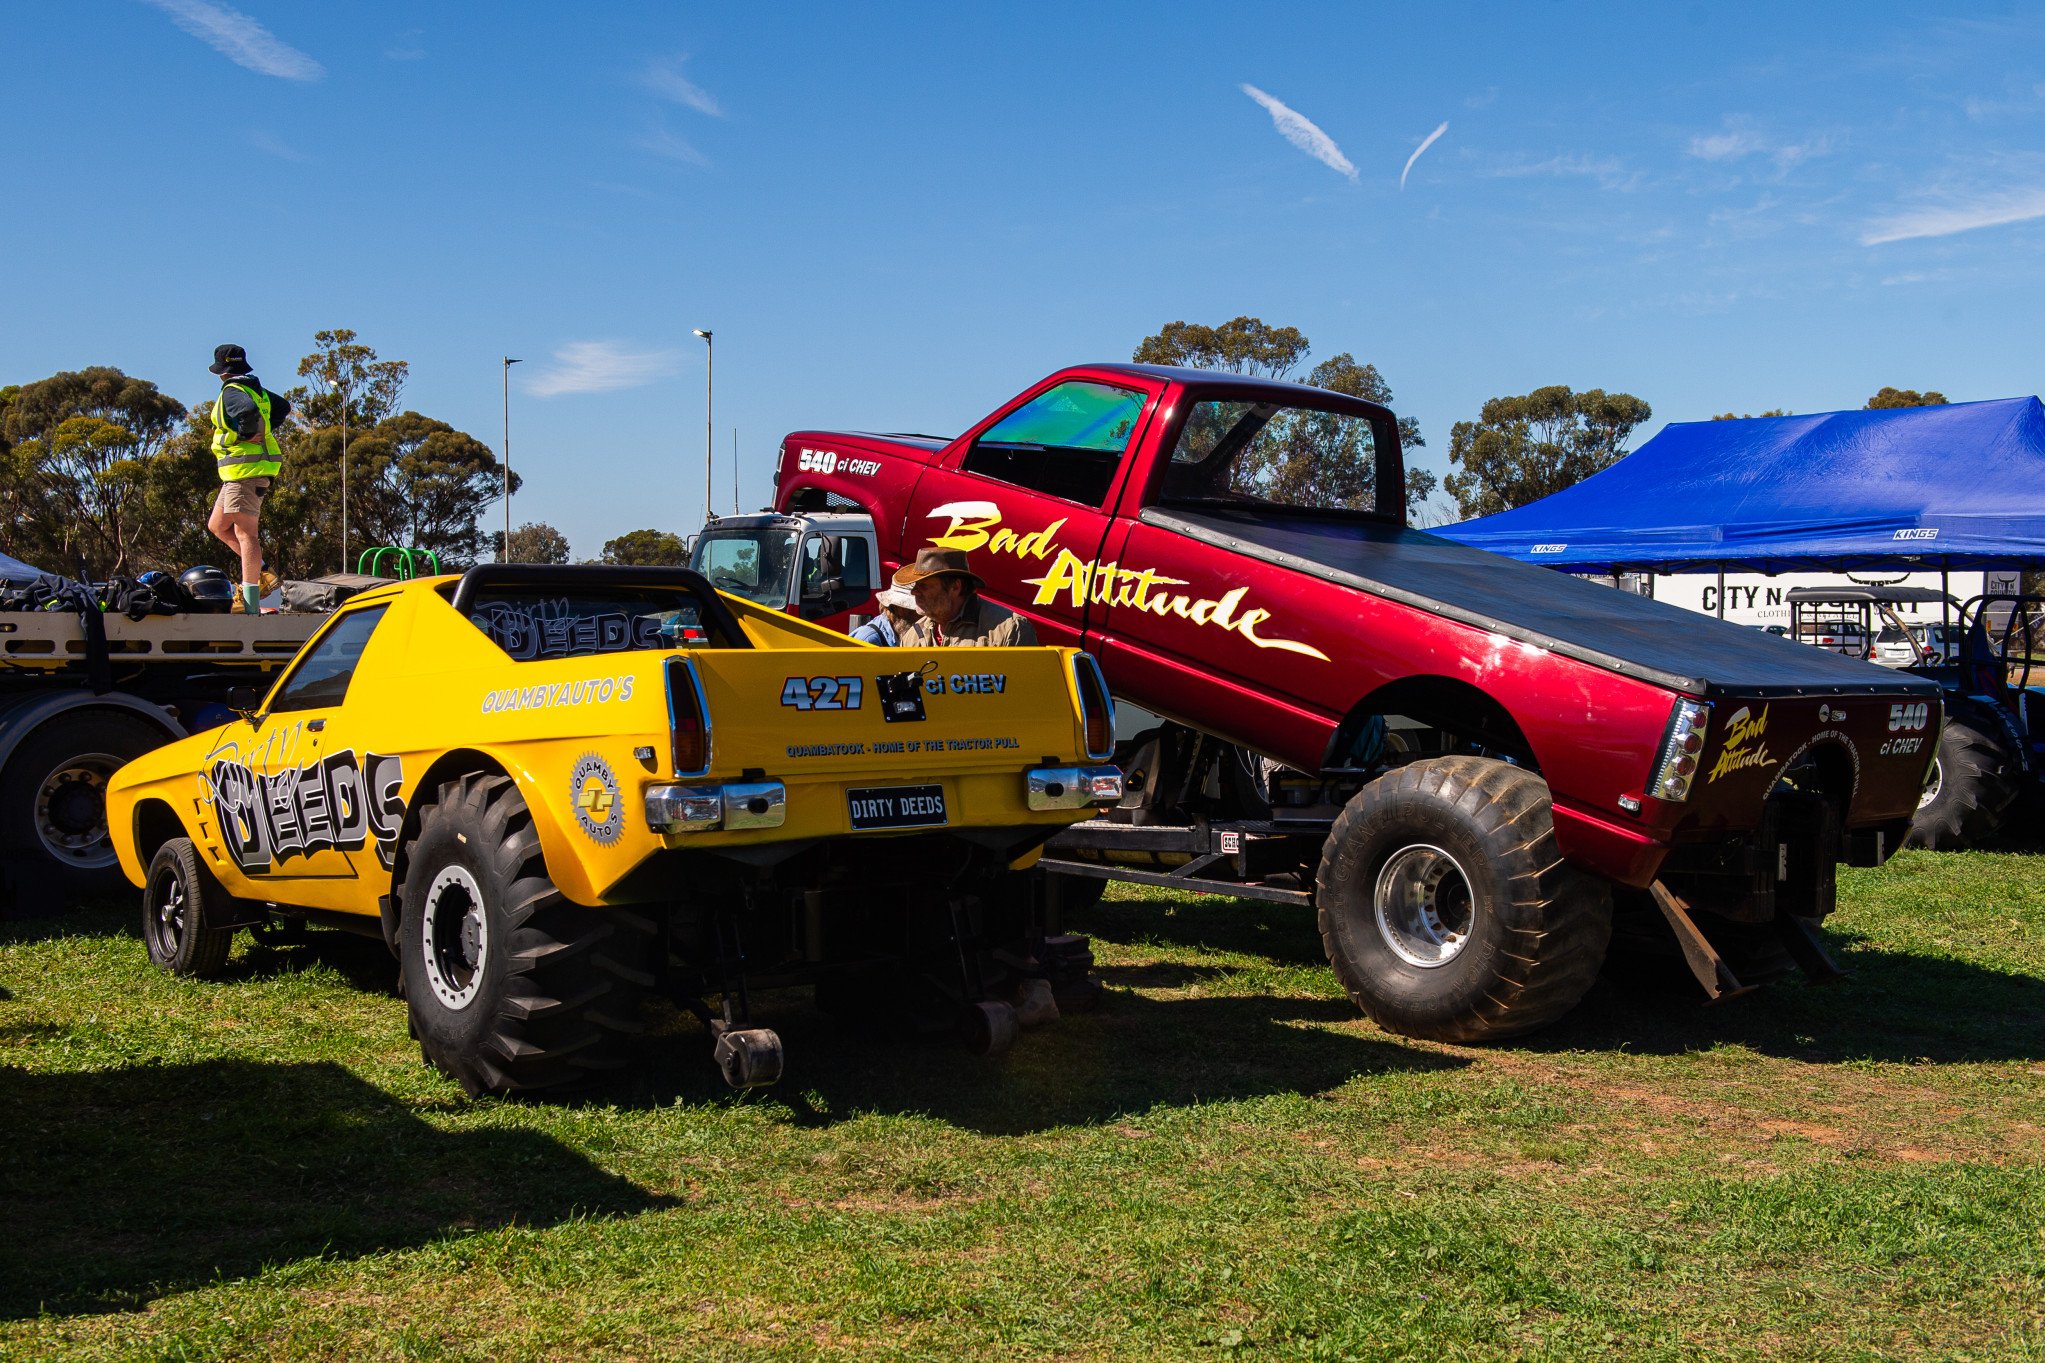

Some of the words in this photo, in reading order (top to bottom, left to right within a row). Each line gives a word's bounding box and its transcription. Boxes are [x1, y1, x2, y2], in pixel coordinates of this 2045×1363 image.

[799, 448, 838, 475] 540
[837, 458, 849, 472] ci
[849, 459, 881, 477] CHEV
[926, 501, 1068, 560] Bad
[1893, 528, 1939, 540] KINGS
[1531, 544, 1567, 553] KINGS
[1021, 548, 1332, 662] Attitude
[1766, 588, 1782, 605] N
[490, 609, 670, 659] DEEDS
[482, 675, 635, 713] QUAMBYAUTO'S
[781, 676, 863, 711] 427
[925, 675, 946, 694] ci
[950, 674, 1006, 694] CHEV
[1723, 702, 1769, 750] Bad
[1888, 702, 1929, 732] 540
[786, 744, 864, 757] QUAMBATOOK
[874, 742, 904, 753] HOME
[907, 741, 920, 752] OF
[923, 740, 943, 751] THE
[946, 738, 992, 750] TRACTOR
[995, 737, 1019, 749] PULL
[1812, 730, 1829, 743] HOME
[1830, 730, 1839, 738] OF
[1838, 732, 1849, 744] THE
[1880, 739, 1892, 755] ci
[1892, 737, 1923, 754] CHEV
[575, 761, 615, 790] QUAMBY
[1708, 741, 1777, 784] Attitude
[212, 748, 407, 878] DEEDS
[852, 798, 893, 819] DIRTY
[900, 796, 943, 816] DEEDS
[581, 813, 618, 837] AUTO'S
[1402, 801, 1489, 868] PULLER
